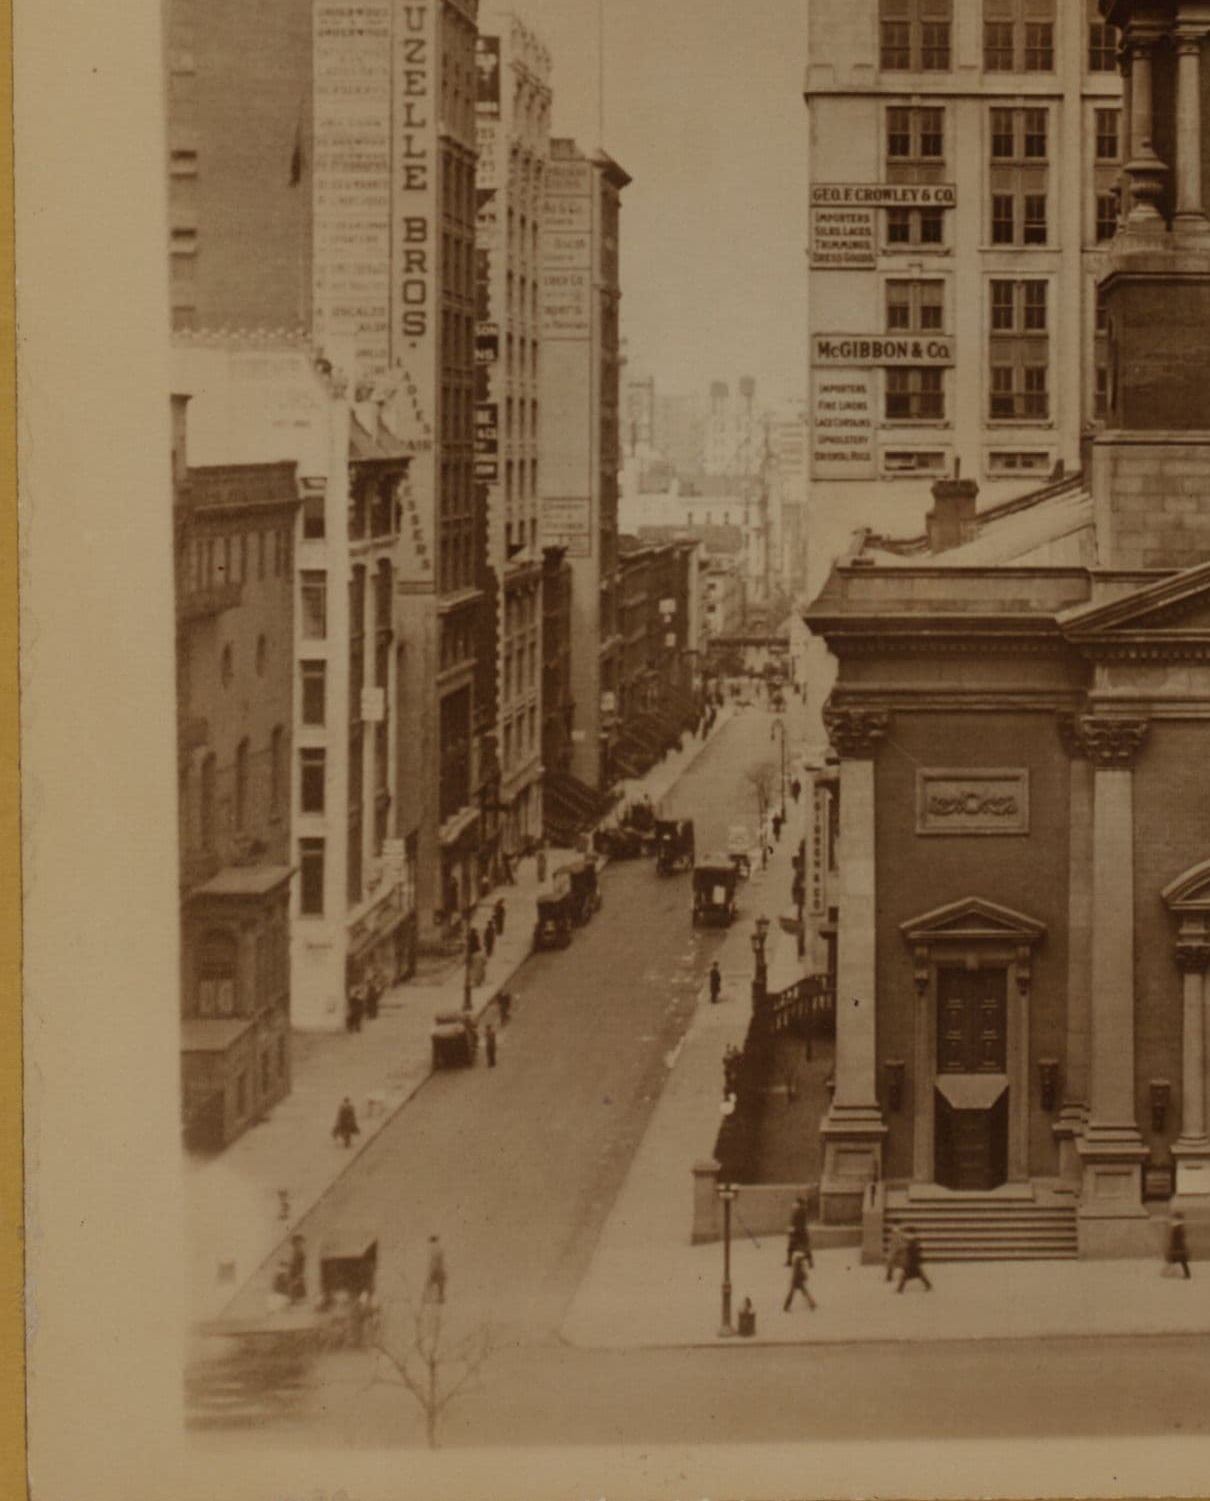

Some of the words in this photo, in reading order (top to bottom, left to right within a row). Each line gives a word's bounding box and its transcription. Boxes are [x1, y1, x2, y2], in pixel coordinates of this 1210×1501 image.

[854, 188, 919, 203] CROWLEY
[922, 188, 932, 202] &
[817, 340, 908, 359] McGIBBON
[911, 341, 923, 358] &
